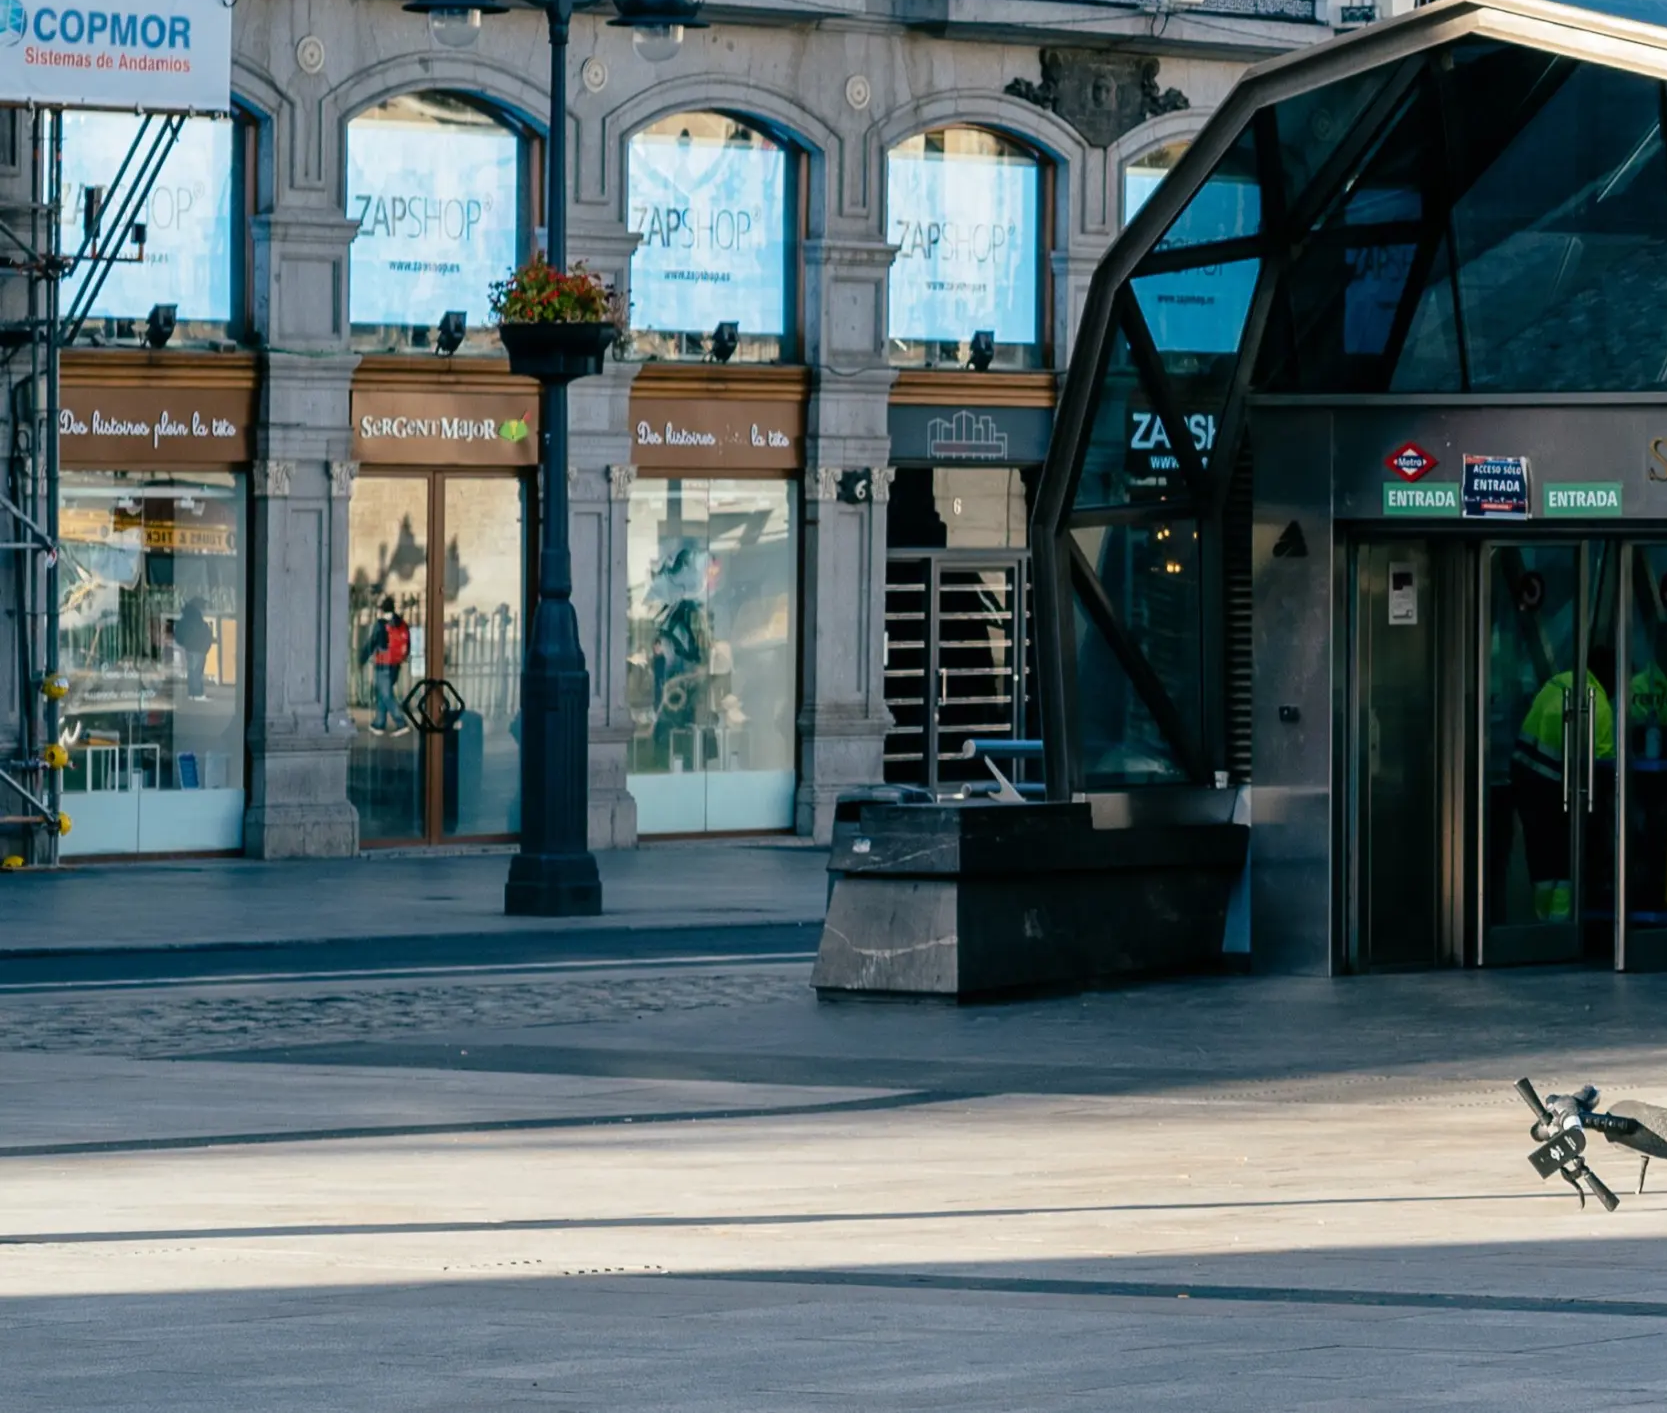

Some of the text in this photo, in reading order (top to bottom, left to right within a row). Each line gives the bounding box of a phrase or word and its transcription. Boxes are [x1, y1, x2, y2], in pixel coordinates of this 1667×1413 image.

[33, 7, 191, 50] COPMOR
[24, 46, 190, 73] Sistemas de Andamios
[355, 194, 482, 240] ZAPSHOP
[633, 206, 751, 251] ZAPSHOP
[896, 219, 1005, 263] ZAPSHOP
[59, 409, 88, 435] Des
[92, 410, 150, 435] histoires
[154, 410, 188, 449] plein
[192, 410, 208, 437] la
[637, 420, 662, 445] Des
[665, 421, 716, 445] histoires
[751, 423, 766, 447] la
[1398, 457, 1423, 467] Metro
[1473, 464, 1522, 476] ACCESO SÓLO
[855, 479, 868, 500] 6
[1473, 478, 1521, 493] ENTRADA
[953, 498, 963, 515] 6
[1388, 490, 1456, 507] ENTRADA
[1548, 490, 1618, 508] ENTRADA
